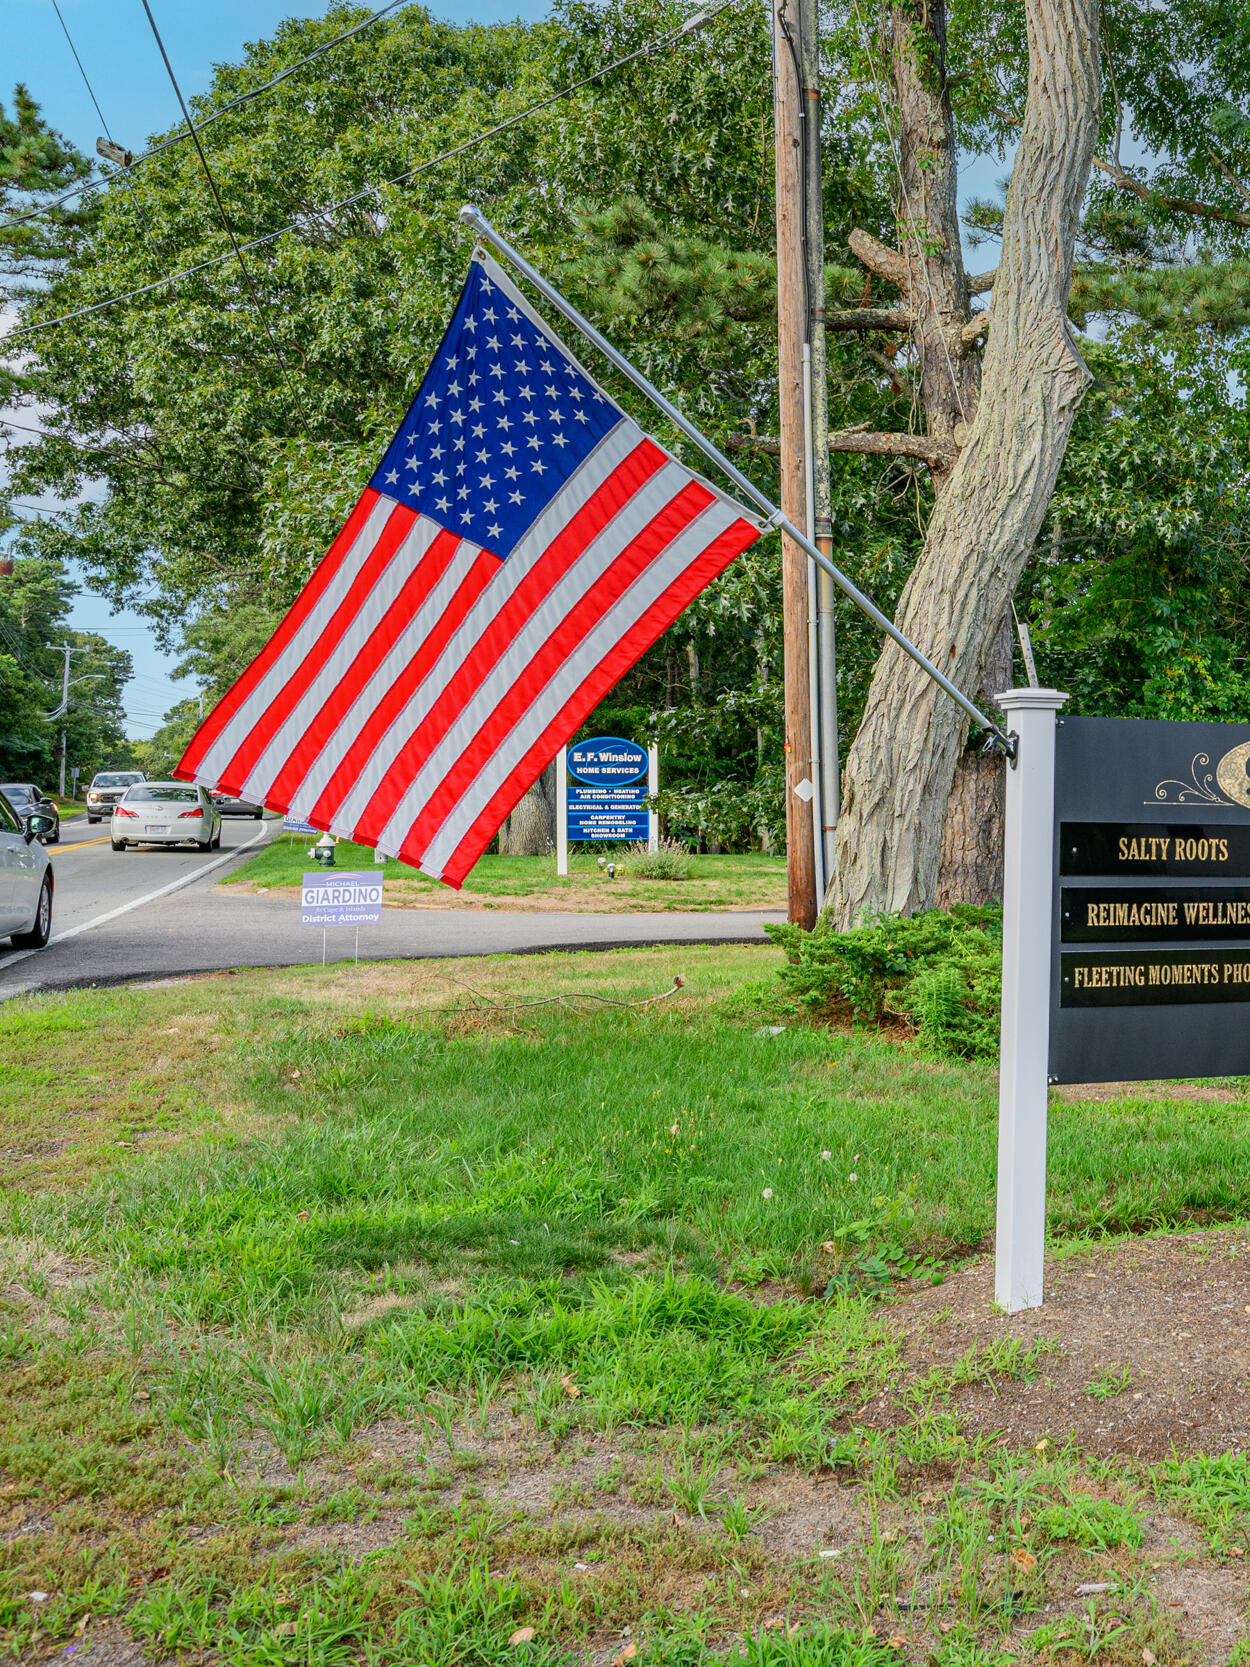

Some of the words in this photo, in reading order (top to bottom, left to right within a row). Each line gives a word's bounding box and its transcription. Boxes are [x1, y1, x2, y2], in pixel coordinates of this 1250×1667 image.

[573, 752, 586, 762] E.
[586, 752, 598, 762] F.
[599, 752, 642, 762] Winslow
[1118, 837, 1170, 861] SALTY
[1174, 838, 1229, 861] ROOTS
[304, 887, 380, 905] GIARDINO
[302, 915, 337, 923] District
[338, 913, 379, 922] Attorney
[1087, 903, 1179, 926] REIMAGINE
[1073, 966, 1145, 988] FLEETING
[1148, 964, 1219, 986] MOMENTS
